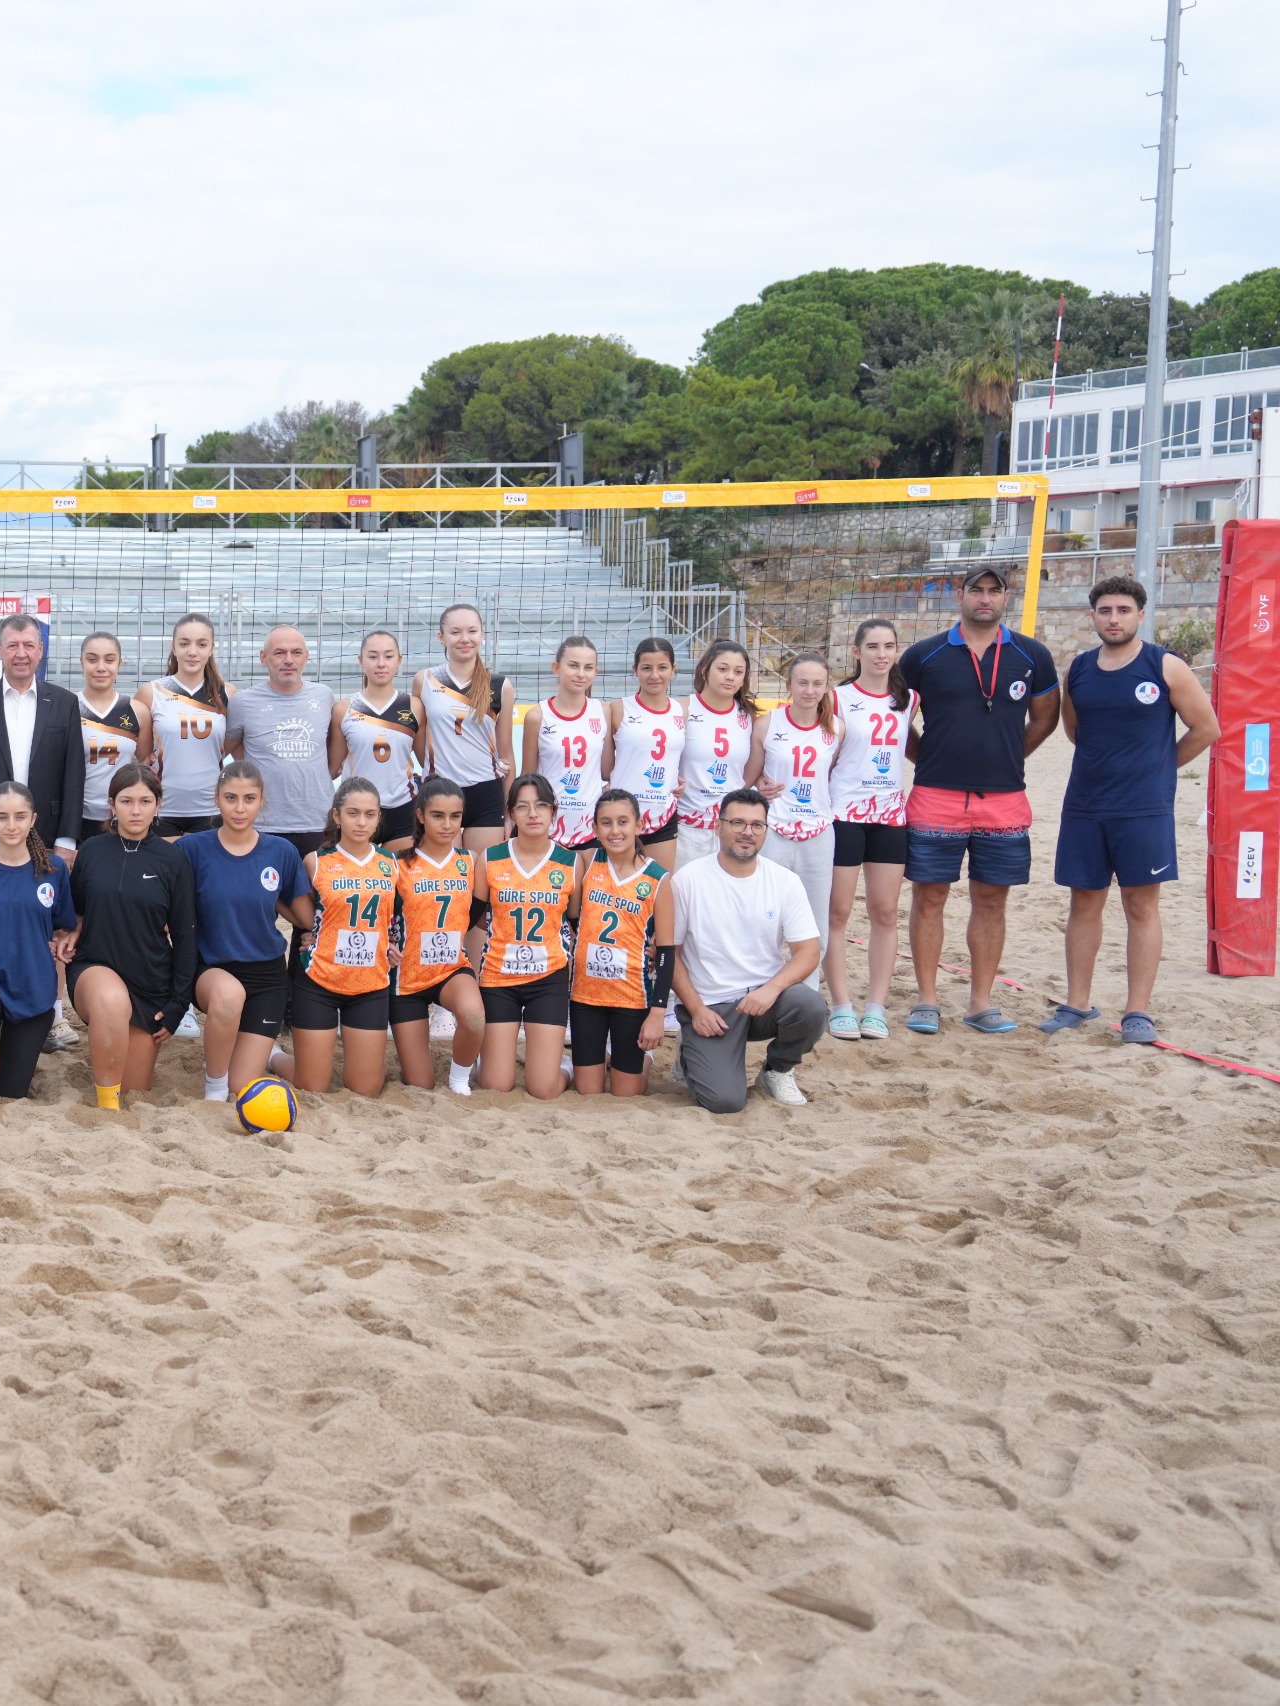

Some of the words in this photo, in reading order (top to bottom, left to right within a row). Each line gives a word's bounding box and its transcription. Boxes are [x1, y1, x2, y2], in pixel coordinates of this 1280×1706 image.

[1259, 594, 1269, 617] TVF
[178, 711, 213, 740] 10
[869, 713, 899, 746] 22
[87, 736, 120, 765] 14
[272, 740, 315, 752] VOLLEYBALL
[373, 731, 391, 763] 6
[562, 735, 587, 768] 13
[651, 728, 667, 761] 3
[714, 727, 730, 758] 5
[715, 763, 728, 777] HB
[792, 746, 817, 777] 12
[879, 751, 891, 765] HB
[567, 773, 581, 786] HB
[651, 766, 665, 780] HB
[799, 783, 812, 797] HB
[1247, 846, 1255, 867] CEV
[332, 877, 362, 891] GÜRE
[365, 879, 393, 891] SPOR
[414, 879, 440, 893] GÜRE
[443, 880, 468, 892] SPOR
[498, 888, 526, 903] GÜRE
[529, 891, 559, 905] SPOR
[345, 893, 380, 928] 14
[435, 895, 452, 929] 7
[588, 888, 614, 907] GÜRE
[615, 897, 641, 915] SPOR
[509, 907, 546, 942] 12
[599, 910, 619, 945] 2
